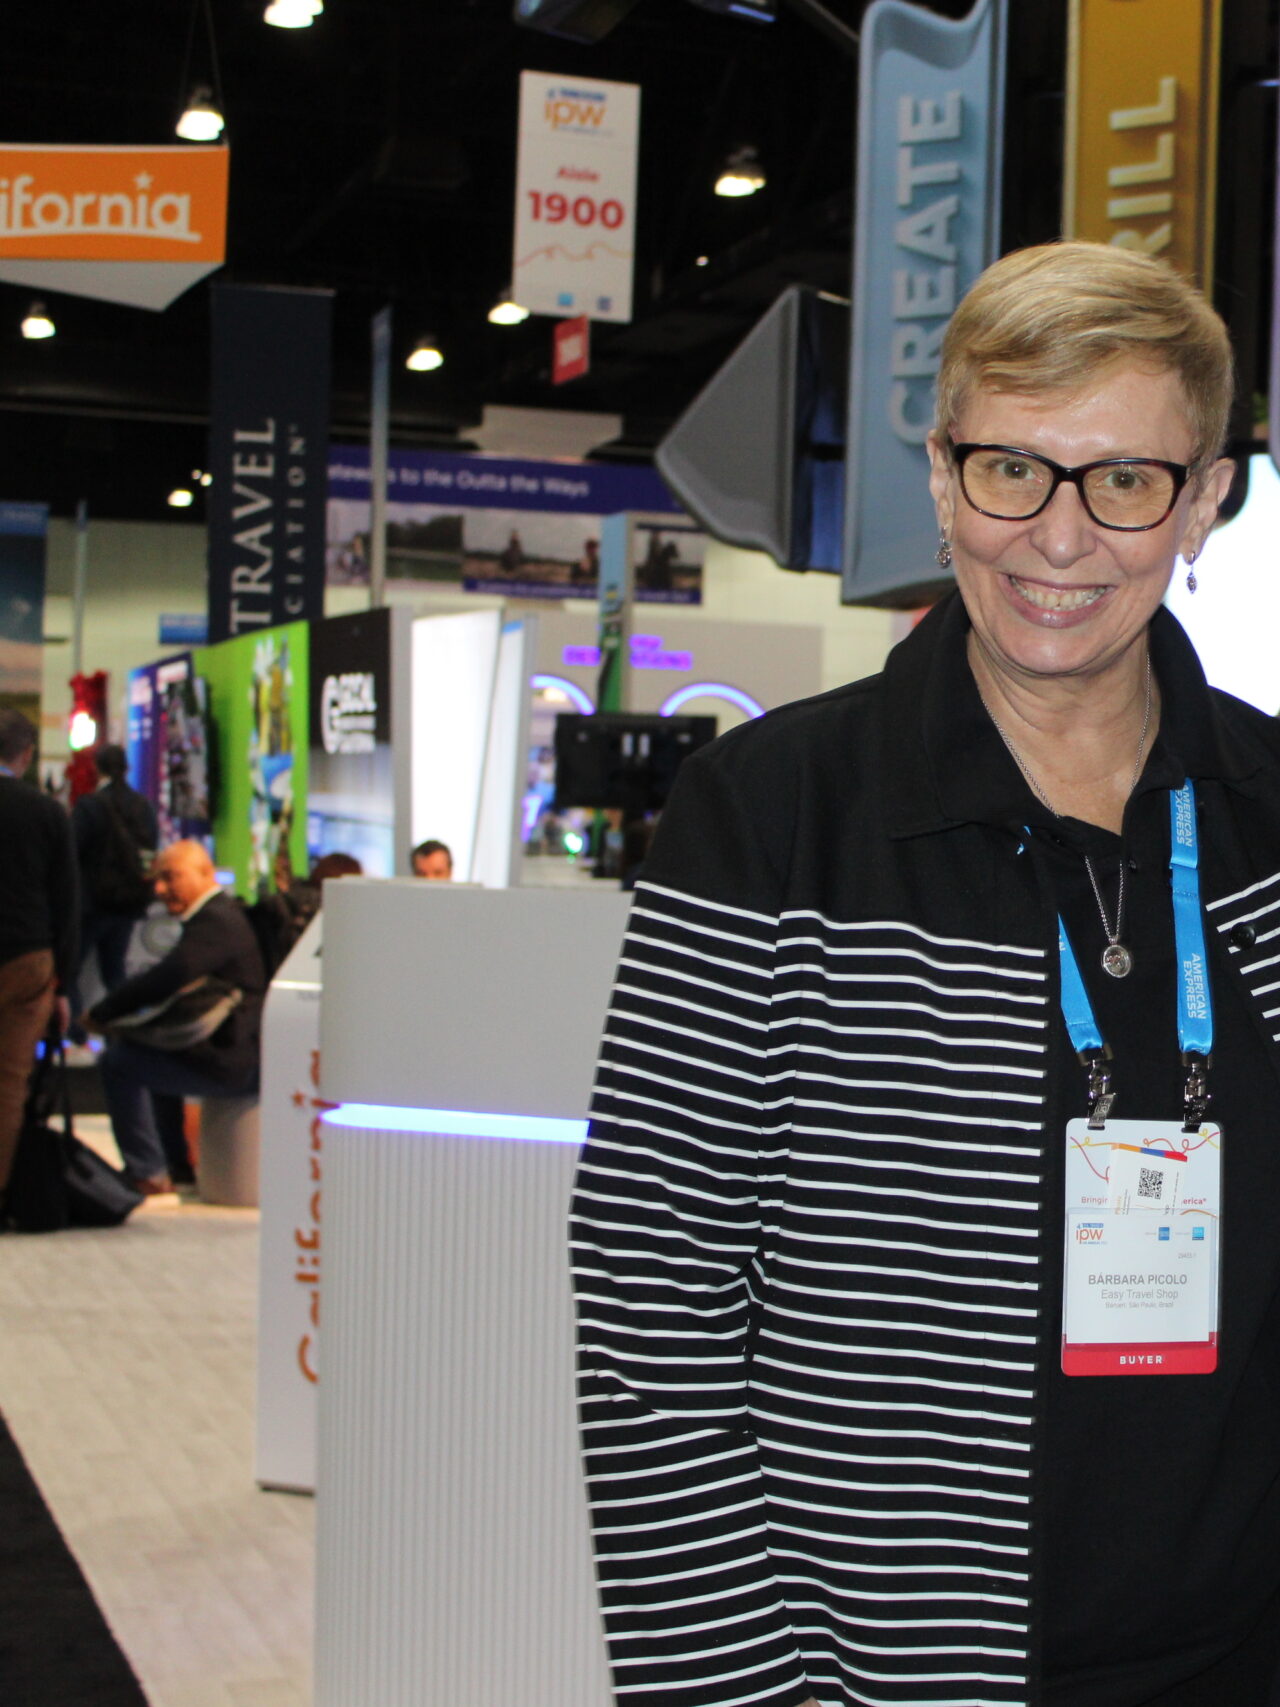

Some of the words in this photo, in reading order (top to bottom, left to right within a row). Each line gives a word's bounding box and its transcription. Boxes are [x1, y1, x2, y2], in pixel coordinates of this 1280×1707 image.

[528, 190, 625, 230] 1900
[888, 88, 962, 444] CREATE
[230, 418, 276, 634] TRAVEL
[1175, 789, 1185, 844] EXPRESS
[1182, 785, 1193, 847] AMERICAN
[1183, 960, 1197, 1019] EXPRESS
[1192, 953, 1207, 1019] AMERICAN
[1076, 1228, 1104, 1245] ipw
[1101, 1289, 1124, 1301] Easy
[1127, 1289, 1154, 1299] Travel
[1156, 1289, 1179, 1300] Shop
[1148, 1274, 1188, 1285] PICOLO
[1120, 1355, 1163, 1364] BUYER
